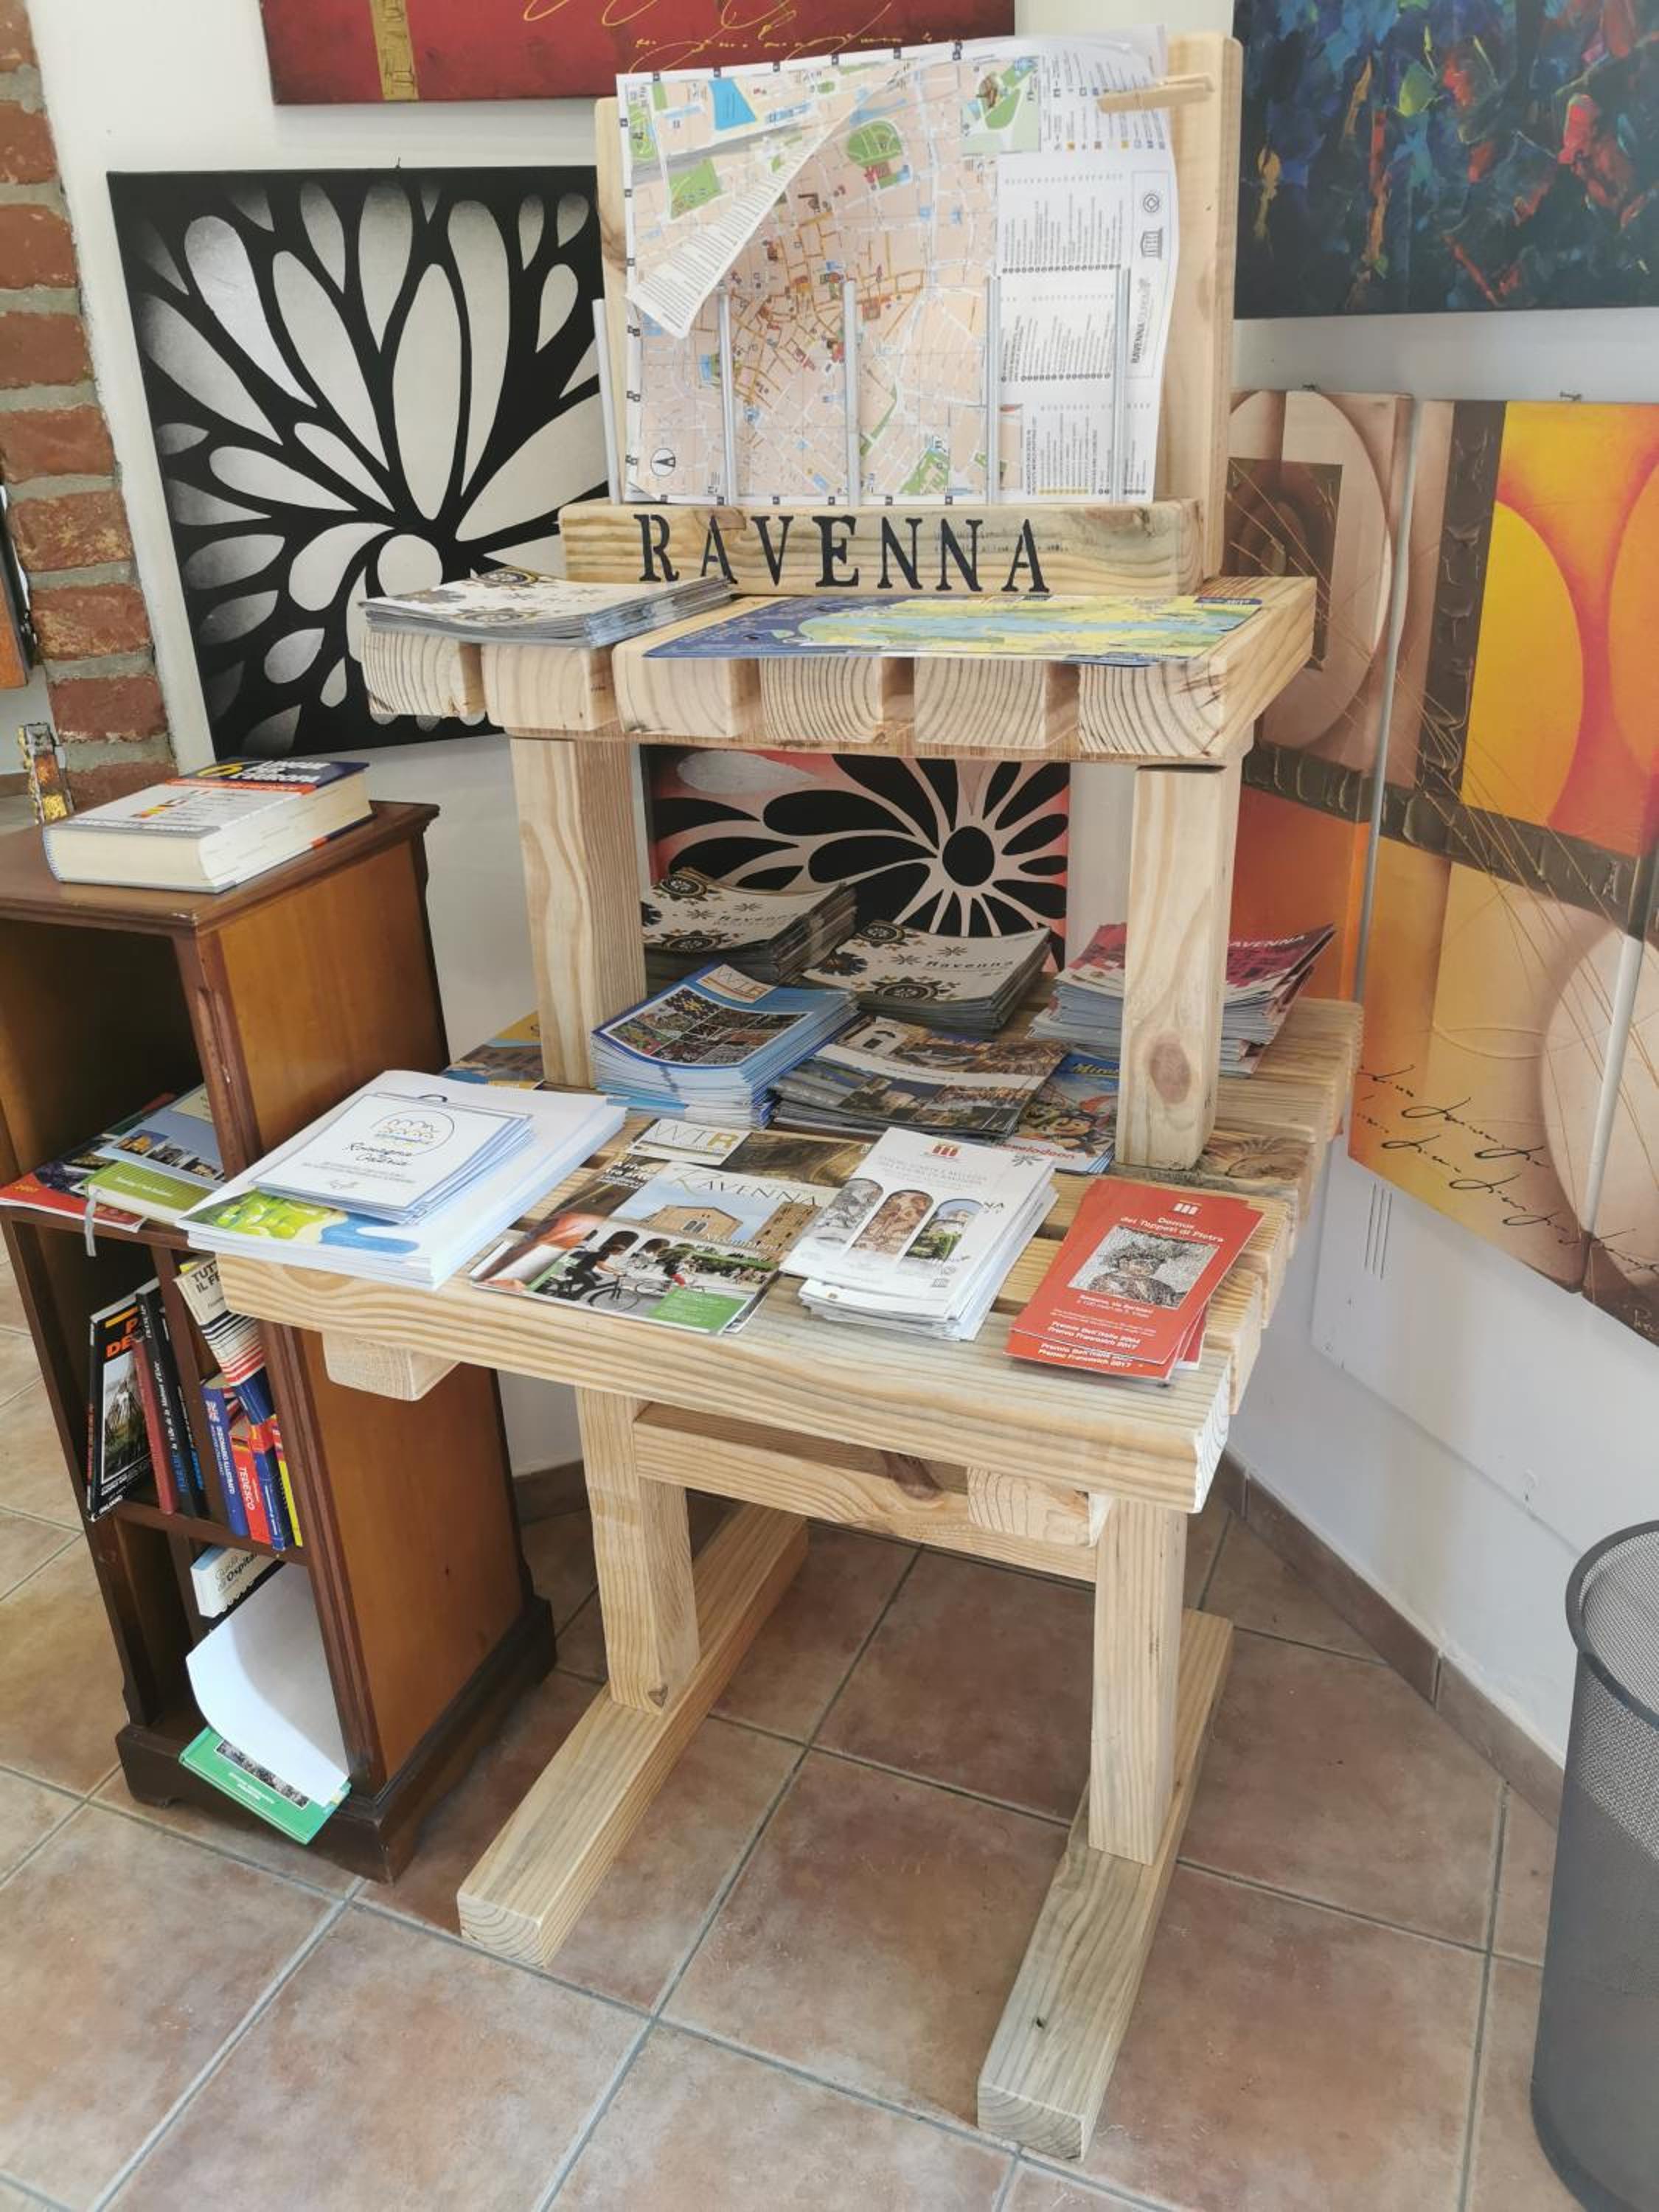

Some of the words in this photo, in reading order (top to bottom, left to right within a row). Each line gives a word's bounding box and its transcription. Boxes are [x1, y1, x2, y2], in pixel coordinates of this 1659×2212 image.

[633, 514, 1051, 591] RAVENNA
[666, 1168, 815, 1206] RAVENNA
[1140, 1220, 1178, 1234] Tappeti
[1192, 1230, 1224, 1242] Pietra
[1157, 1217, 1194, 1228] Domus
[196, 1281, 208, 1293] IL
[1110, 1359, 1133, 1368] 2017
[238, 1467, 255, 1511] TEDESCO
